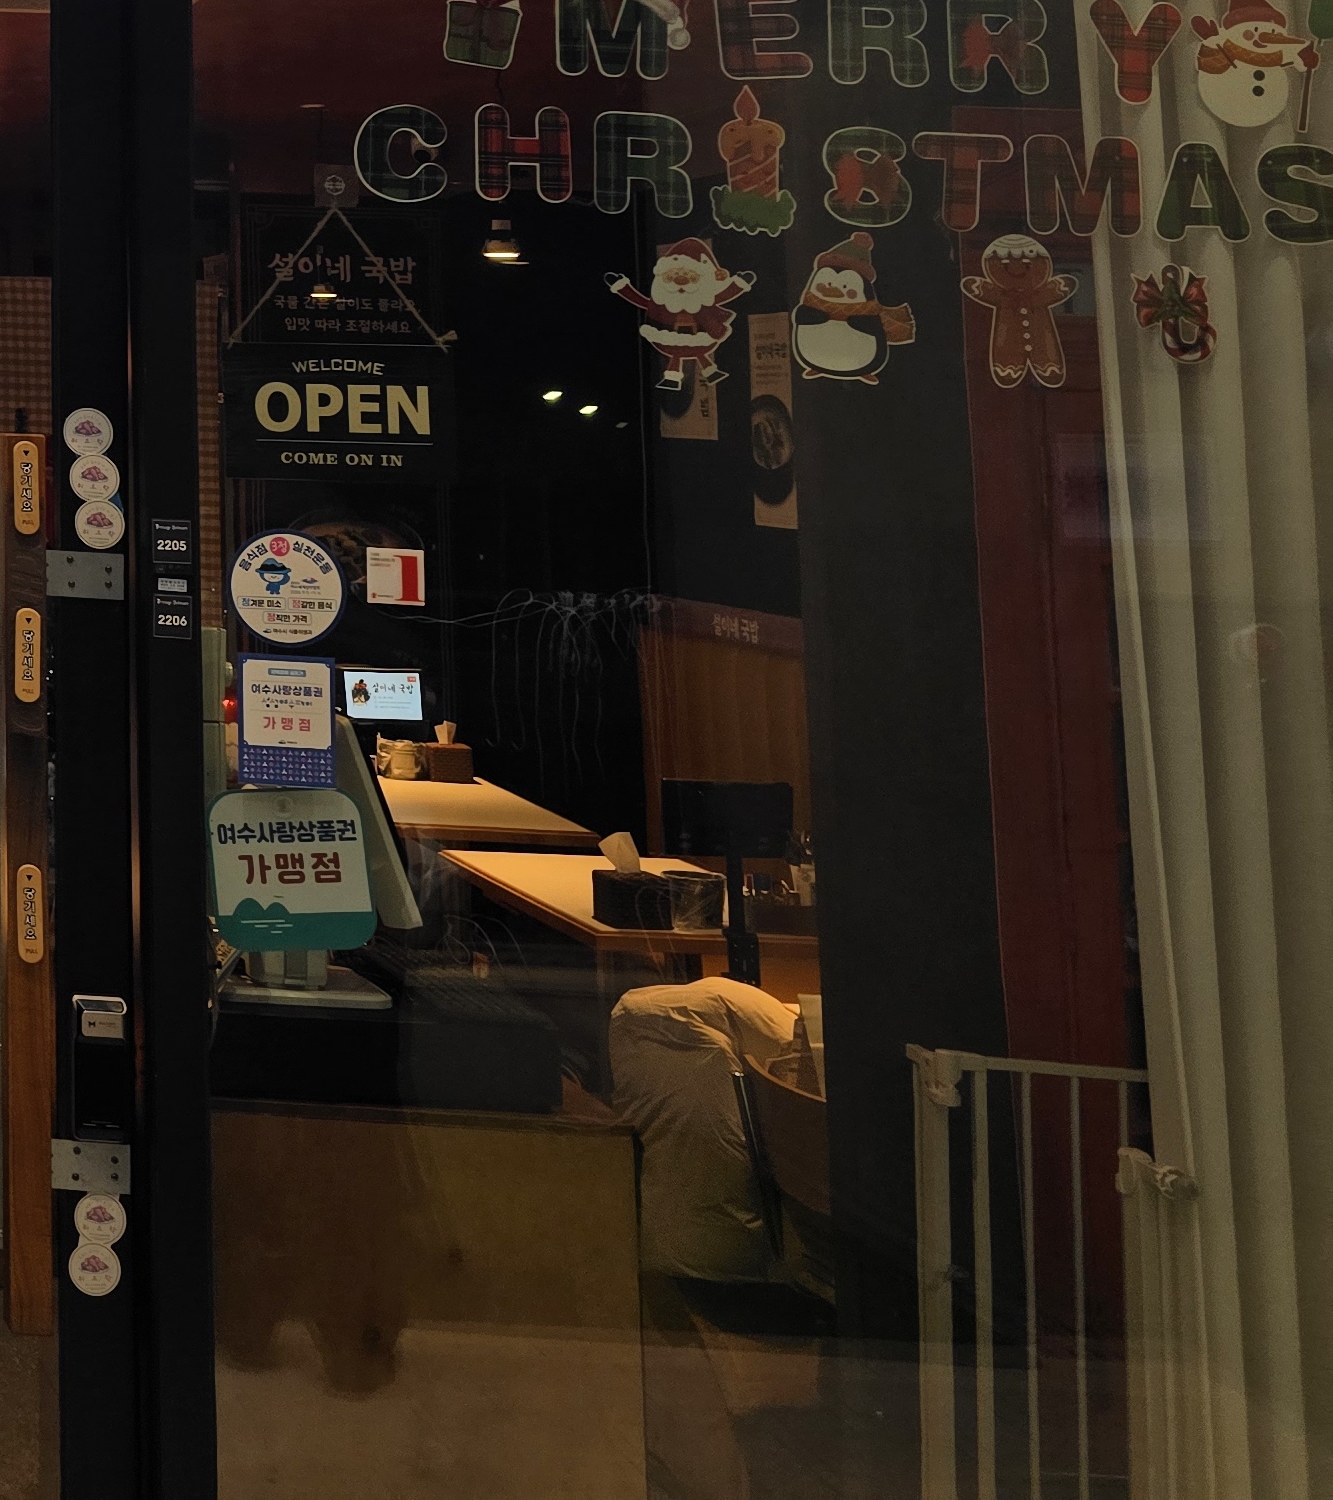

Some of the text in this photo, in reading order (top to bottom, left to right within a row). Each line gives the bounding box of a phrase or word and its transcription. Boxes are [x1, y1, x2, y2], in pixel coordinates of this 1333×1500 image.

[267, 253, 416, 286] 설이네 국밥
[284, 317, 310, 331] 입맛
[314, 318, 341, 332] 따라
[292, 358, 385, 375] WELCOME
[254, 381, 431, 435] OPEN
[280, 451, 403, 467] COME ON IN
[20, 462, 33, 512] 당기세요
[156, 540, 187, 551] 2205
[157, 614, 188, 627] 2206
[22, 630, 35, 681] 당기세요
[251, 683, 323, 697] 여수사랑상품권
[217, 819, 358, 845] 여수사랑상품권
[238, 851, 342, 885] 가맹점
[23, 887, 36, 940] 당기세요
